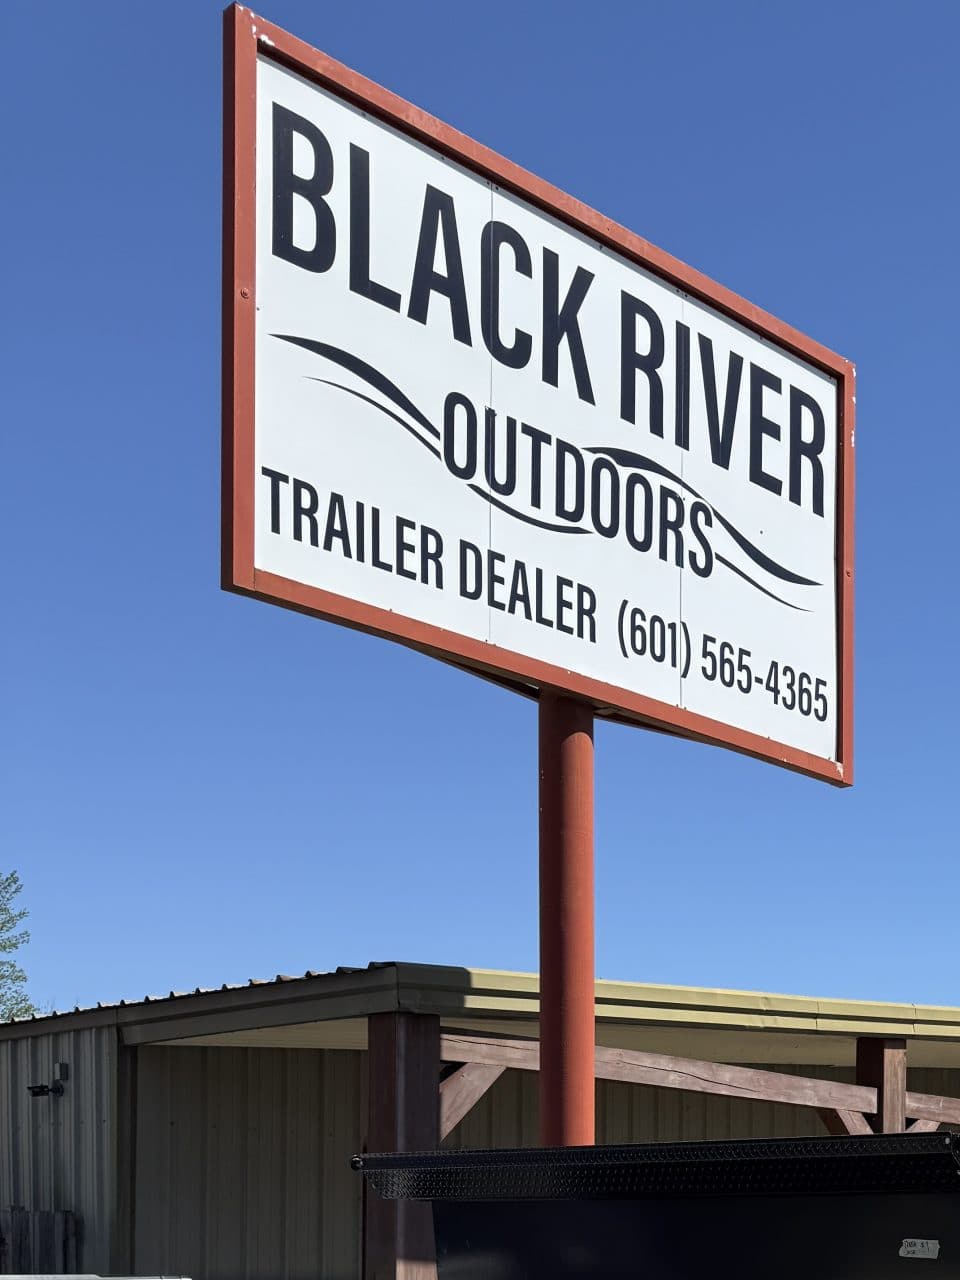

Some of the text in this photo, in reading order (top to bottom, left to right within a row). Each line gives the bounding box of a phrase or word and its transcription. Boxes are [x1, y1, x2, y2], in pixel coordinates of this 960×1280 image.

[271, 101, 826, 519] BLACK RIVER
[261, 466, 829, 723] TRAILER DEALER (601) 565-4365
[443, 391, 715, 579] OUTDOORS
